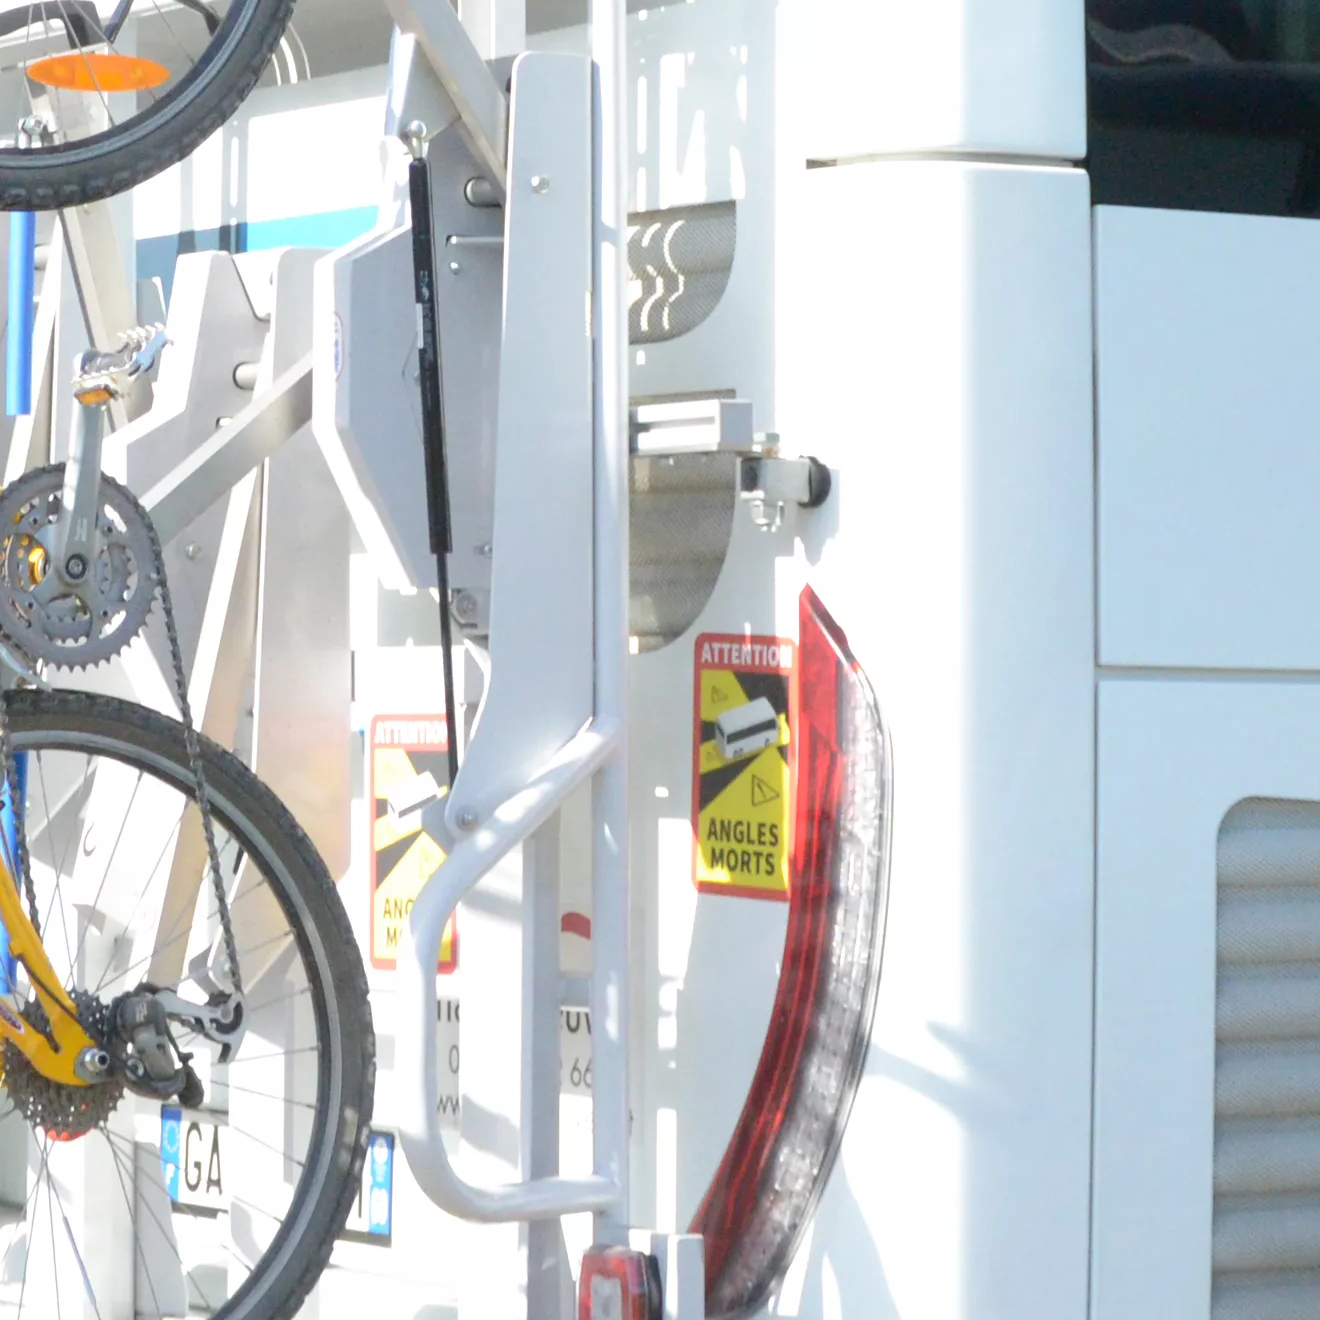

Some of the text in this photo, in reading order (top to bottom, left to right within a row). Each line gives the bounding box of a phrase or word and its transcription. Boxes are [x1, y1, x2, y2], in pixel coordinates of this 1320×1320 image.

[700, 641, 793, 669] ATTENTION
[706, 817, 779, 847] ANGLES
[710, 845, 777, 877] MORTS
